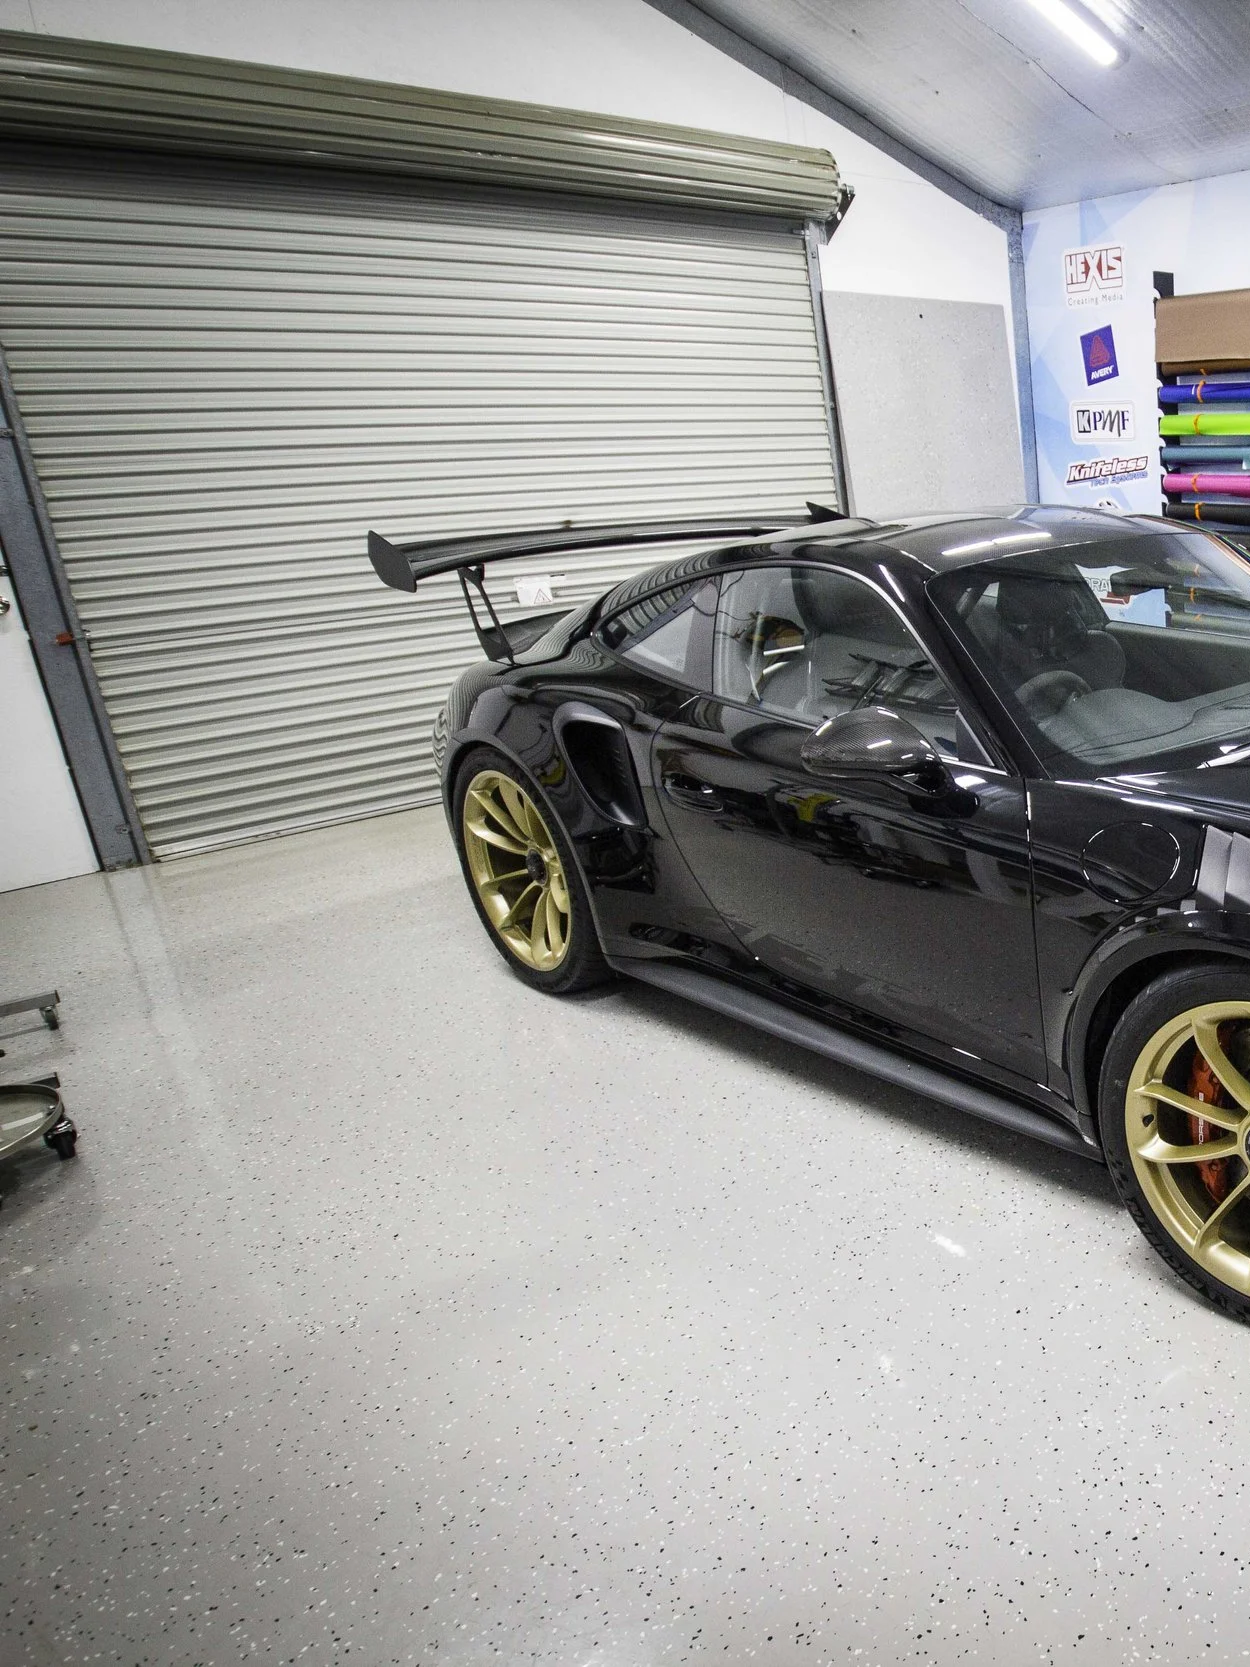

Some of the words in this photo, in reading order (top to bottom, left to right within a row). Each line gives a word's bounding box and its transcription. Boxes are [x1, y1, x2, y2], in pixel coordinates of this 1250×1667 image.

[1064, 246, 1123, 293] HEXIS
[1067, 296, 1099, 307] Creating
[1101, 293, 1124, 303] Media
[1090, 364, 1115, 380] AVERY
[1076, 408, 1130, 437] KPMF
[1067, 455, 1149, 484] Knifeless
